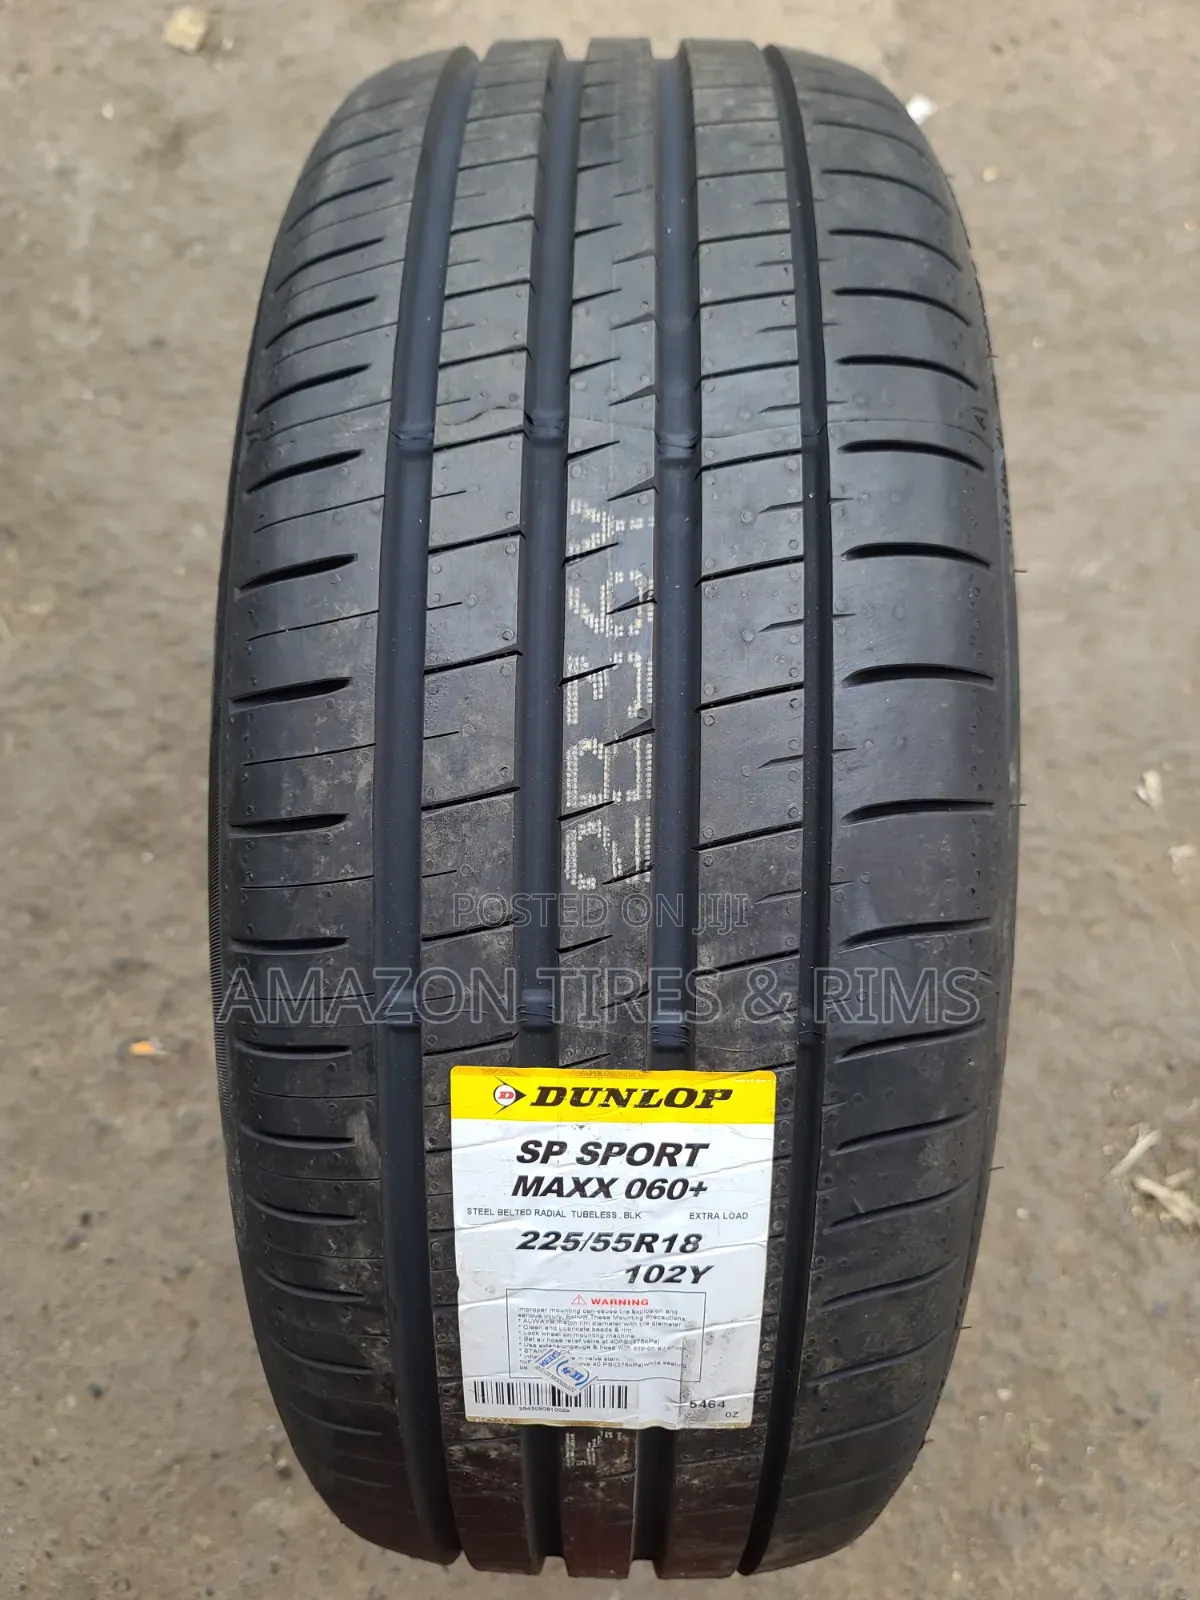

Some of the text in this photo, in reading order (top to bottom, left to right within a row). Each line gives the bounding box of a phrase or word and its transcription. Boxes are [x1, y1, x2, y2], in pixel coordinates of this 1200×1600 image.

[530, 1085, 733, 1109] DUNLOP
[516, 1140, 710, 1167] SP SPORT
[511, 1175, 708, 1200] MAXX 060+
[466, 1207, 495, 1216] STEEL
[497, 1208, 532, 1216] BELTED
[534, 1209, 566, 1218] RADIAL
[623, 1211, 642, 1219] BLK
[689, 1212, 720, 1220] EXTRA
[723, 1211, 749, 1220] LOAD
[516, 1230, 703, 1254] 225/55R18
[625, 1265, 715, 1285] 102Y
[590, 1297, 649, 1306] WARNING
[690, 1400, 726, 1409] 5464
